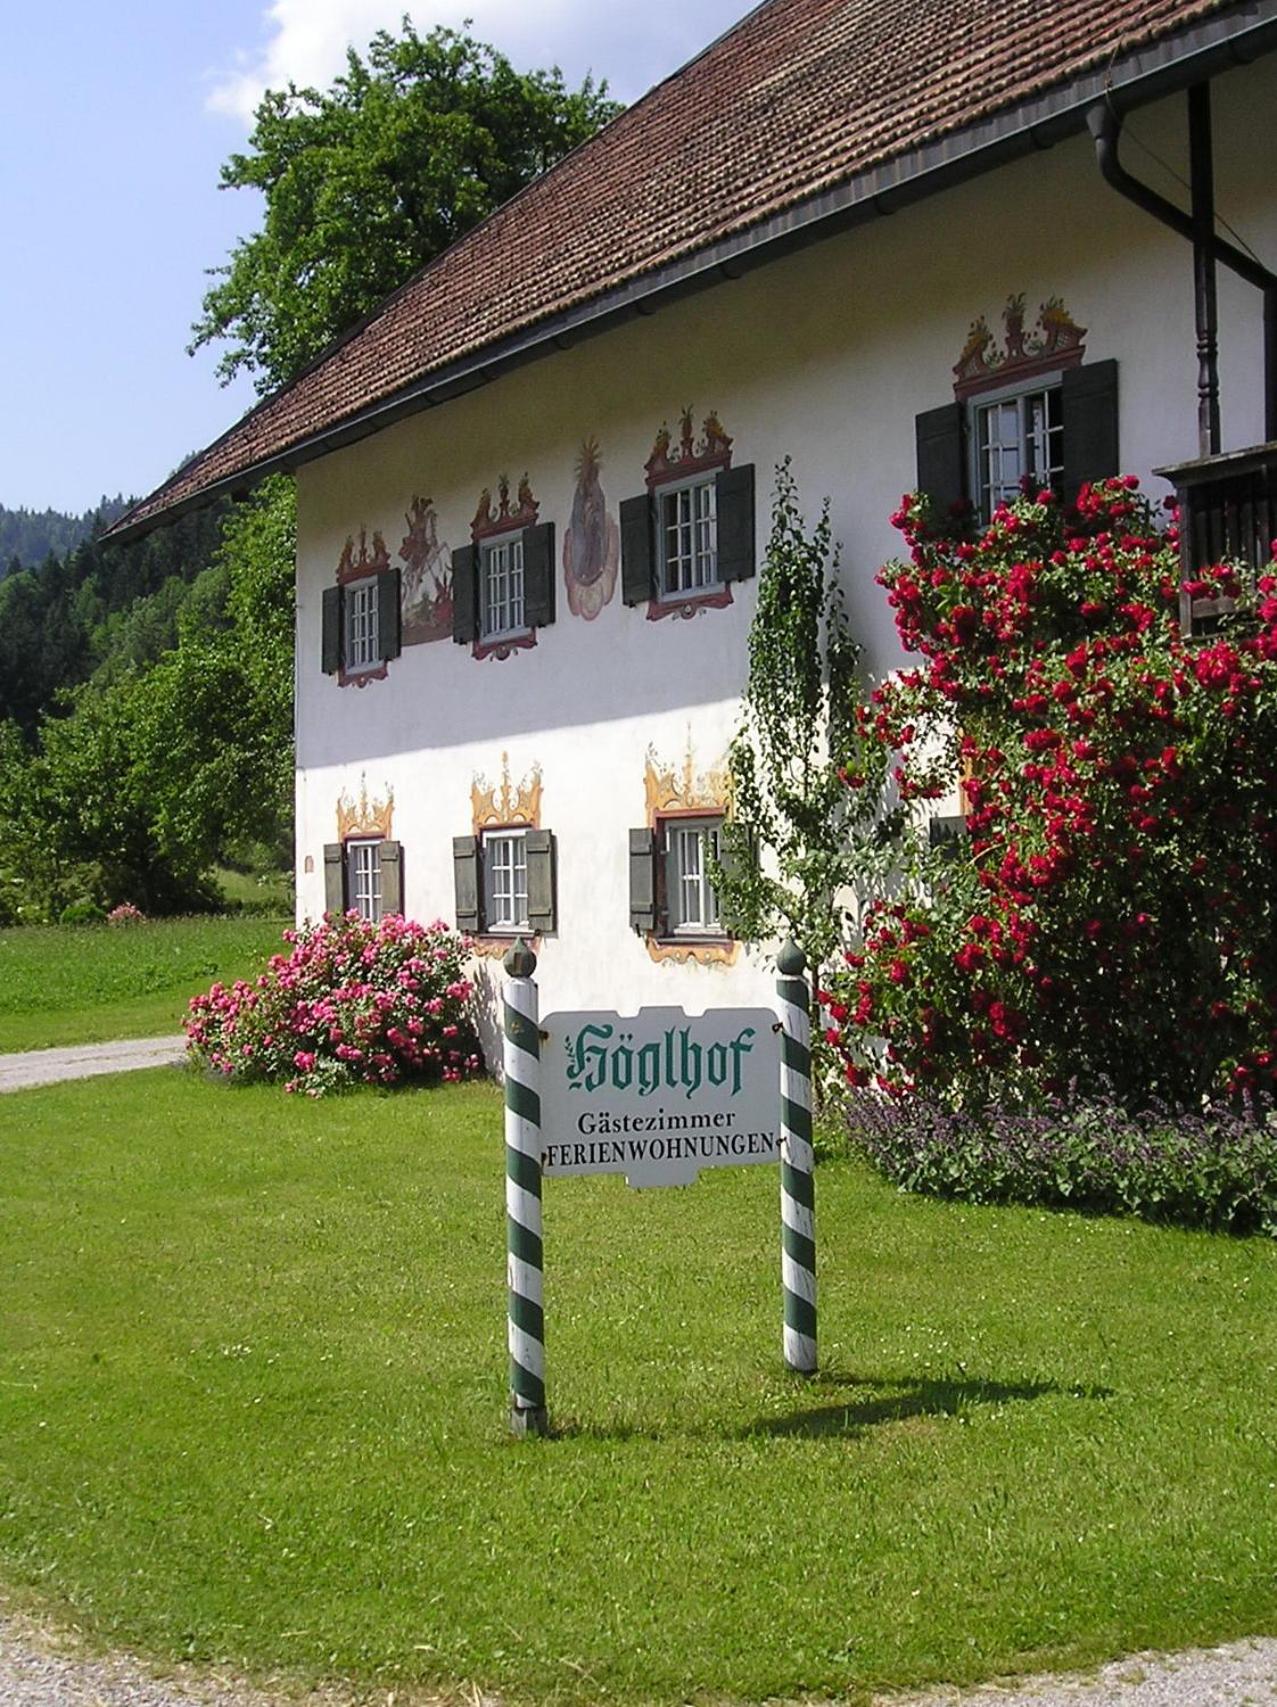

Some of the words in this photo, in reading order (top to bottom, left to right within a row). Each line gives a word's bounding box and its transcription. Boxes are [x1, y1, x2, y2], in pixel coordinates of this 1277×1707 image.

[566, 1023, 756, 1100] Höglhof
[577, 1108, 736, 1135] Gästezimmer
[547, 1132, 775, 1167] FERIENWOHNUNGEN
